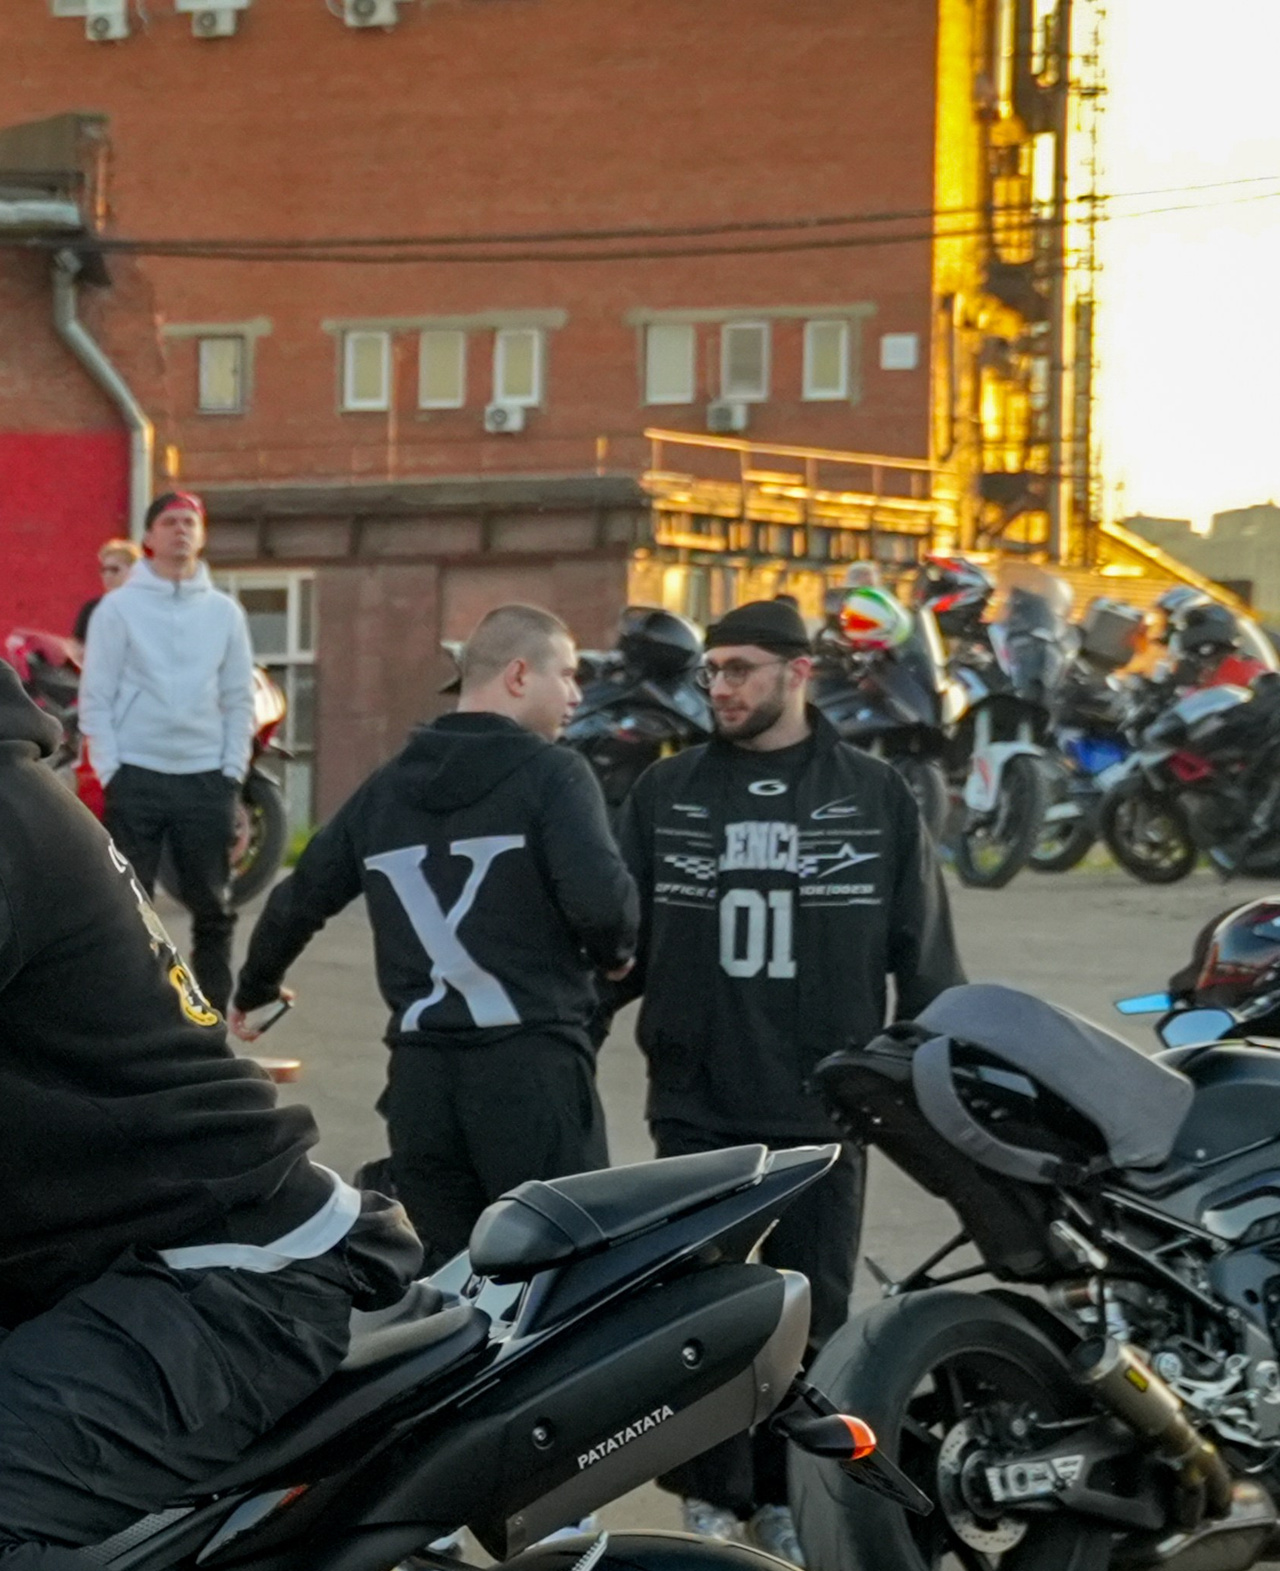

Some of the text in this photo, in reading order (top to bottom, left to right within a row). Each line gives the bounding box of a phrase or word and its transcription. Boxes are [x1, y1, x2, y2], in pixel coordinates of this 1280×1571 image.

[363, 834, 526, 1033] X
[719, 888, 797, 979] 01
[577, 1404, 675, 1470] PATATATA
